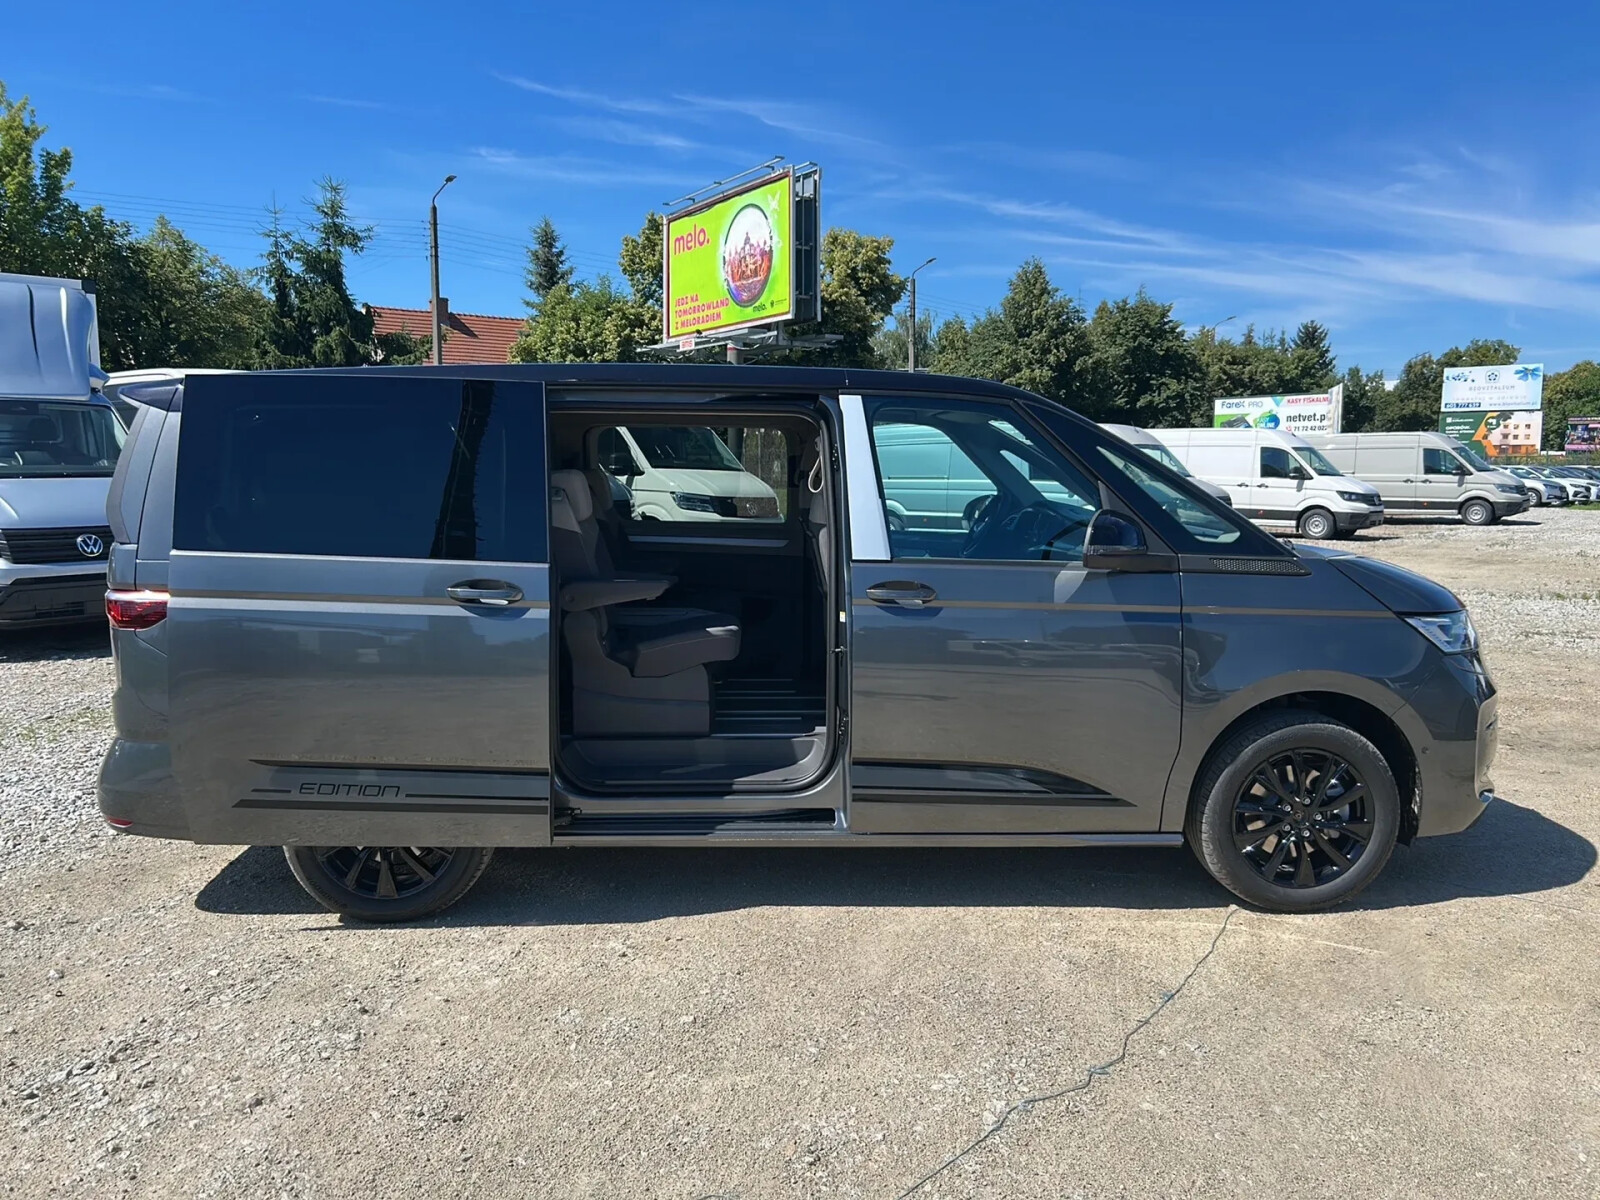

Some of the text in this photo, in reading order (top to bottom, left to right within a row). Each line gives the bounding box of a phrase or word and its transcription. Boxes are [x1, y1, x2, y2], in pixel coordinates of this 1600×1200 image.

[674, 223, 710, 255] melo.
[690, 293, 699, 303] NA
[675, 297, 730, 318] TOMORROWLAND
[680, 311, 722, 329] MELORADIEM
[1248, 400, 1264, 408] PRO
[299, 782, 401, 798] EDITION
